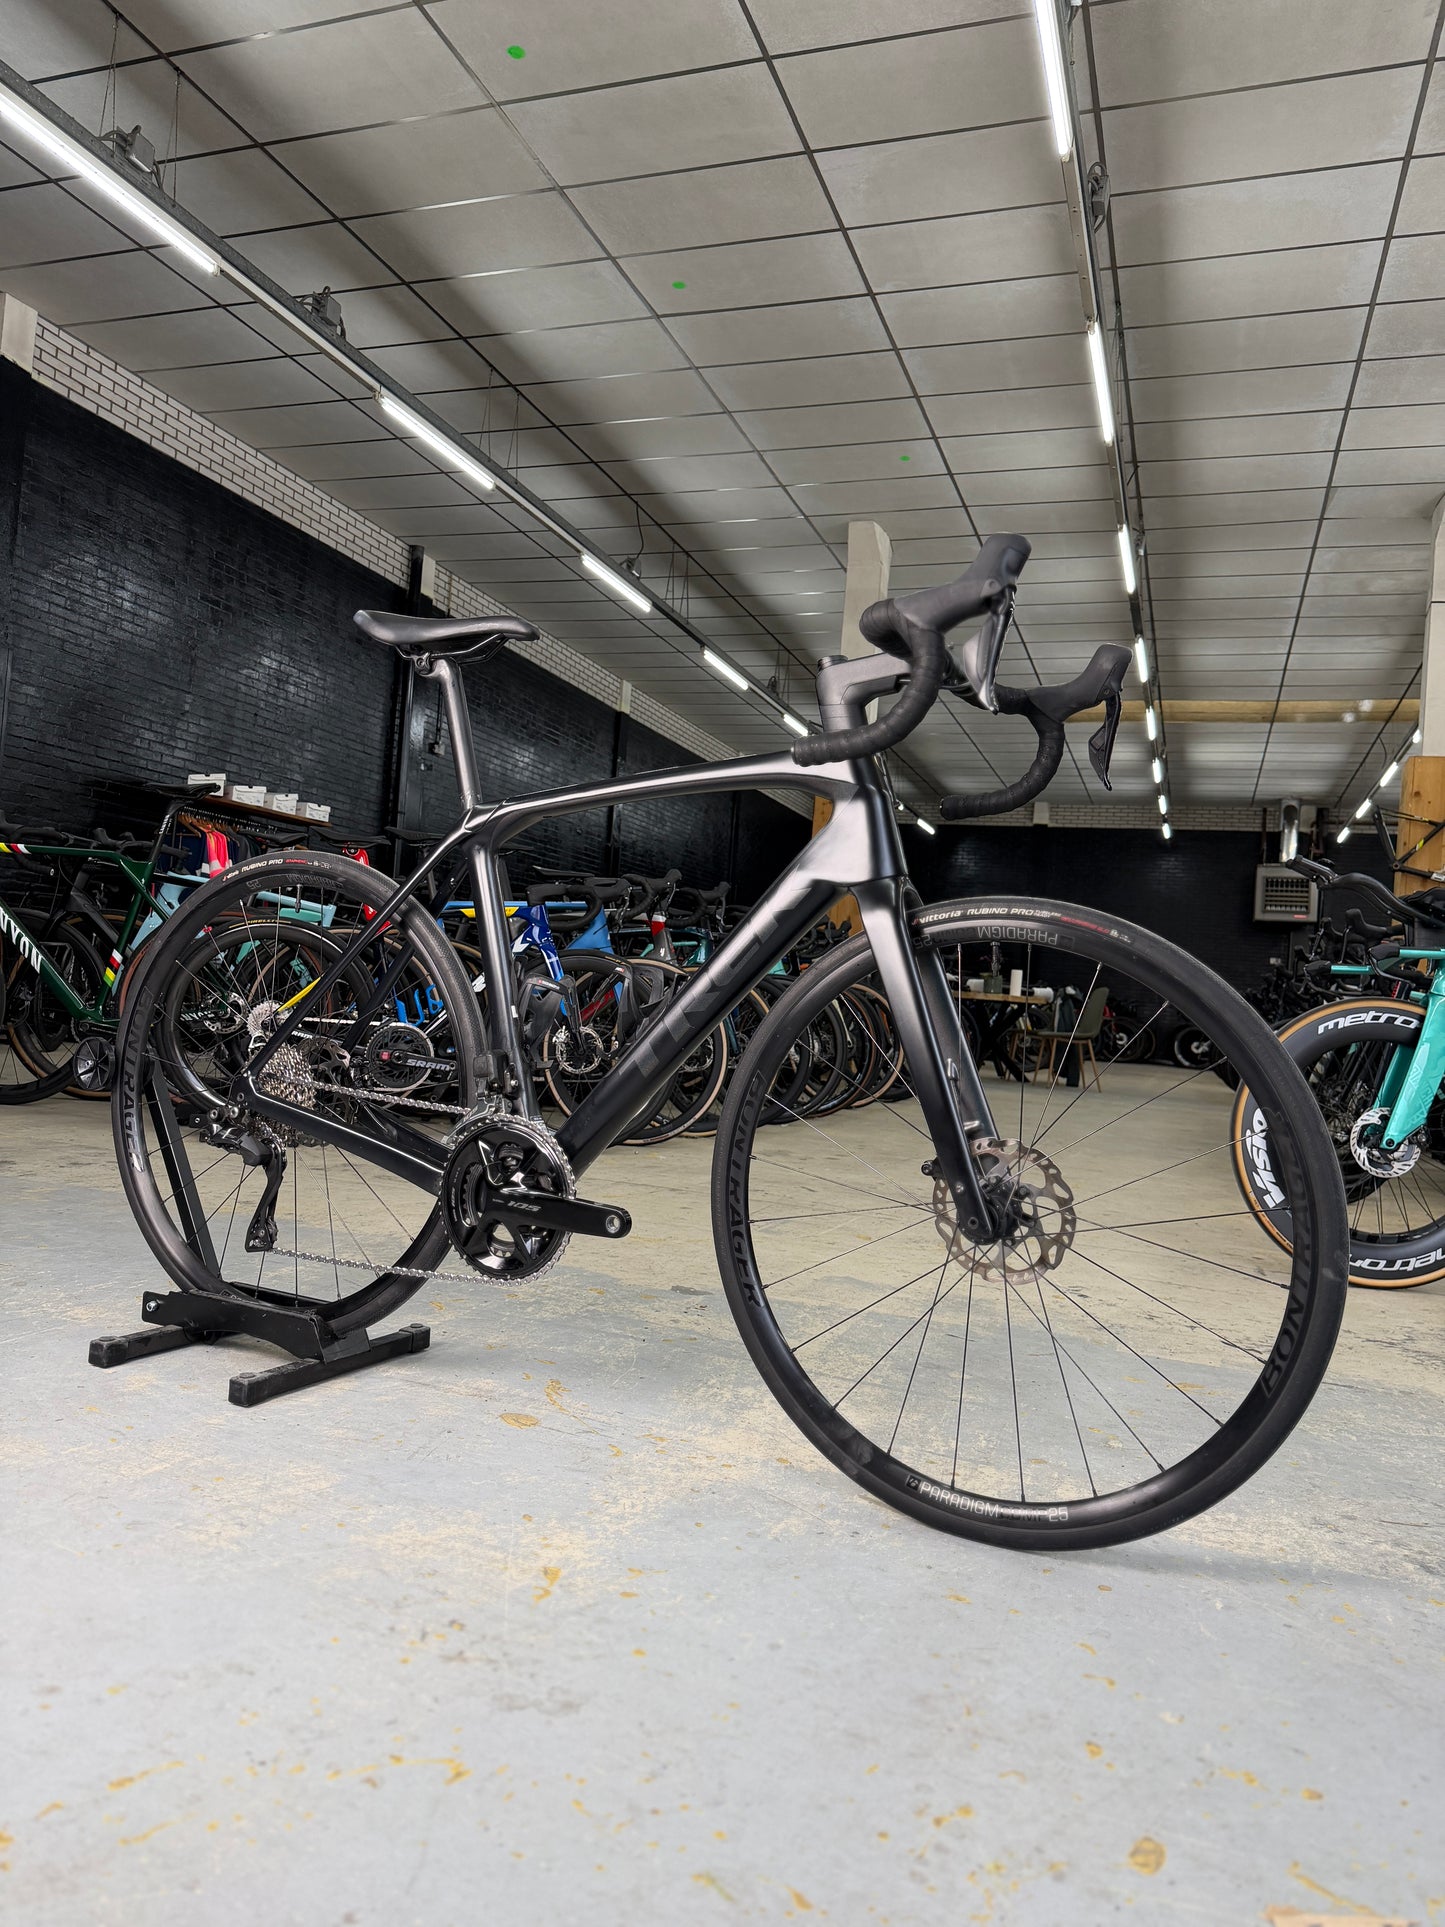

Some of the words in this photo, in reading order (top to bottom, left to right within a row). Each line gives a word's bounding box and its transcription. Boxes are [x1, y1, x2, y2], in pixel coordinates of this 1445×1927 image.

[241, 861, 267, 873] RUBINO
[919, 910, 962, 924] vittoria
[967, 907, 1008, 916] RUBINO
[1010, 908, 1034, 916] PRO
[977, 926, 1059, 946] PARADIGM
[1317, 1010, 1421, 1035] metro
[407, 1059, 450, 1071] SRAM
[729, 1069, 766, 1308] BONTRAGER
[507, 1200, 541, 1212] 105
[919, 1481, 1000, 1518] PARADIGM
[1048, 1506, 1069, 1522] 25
